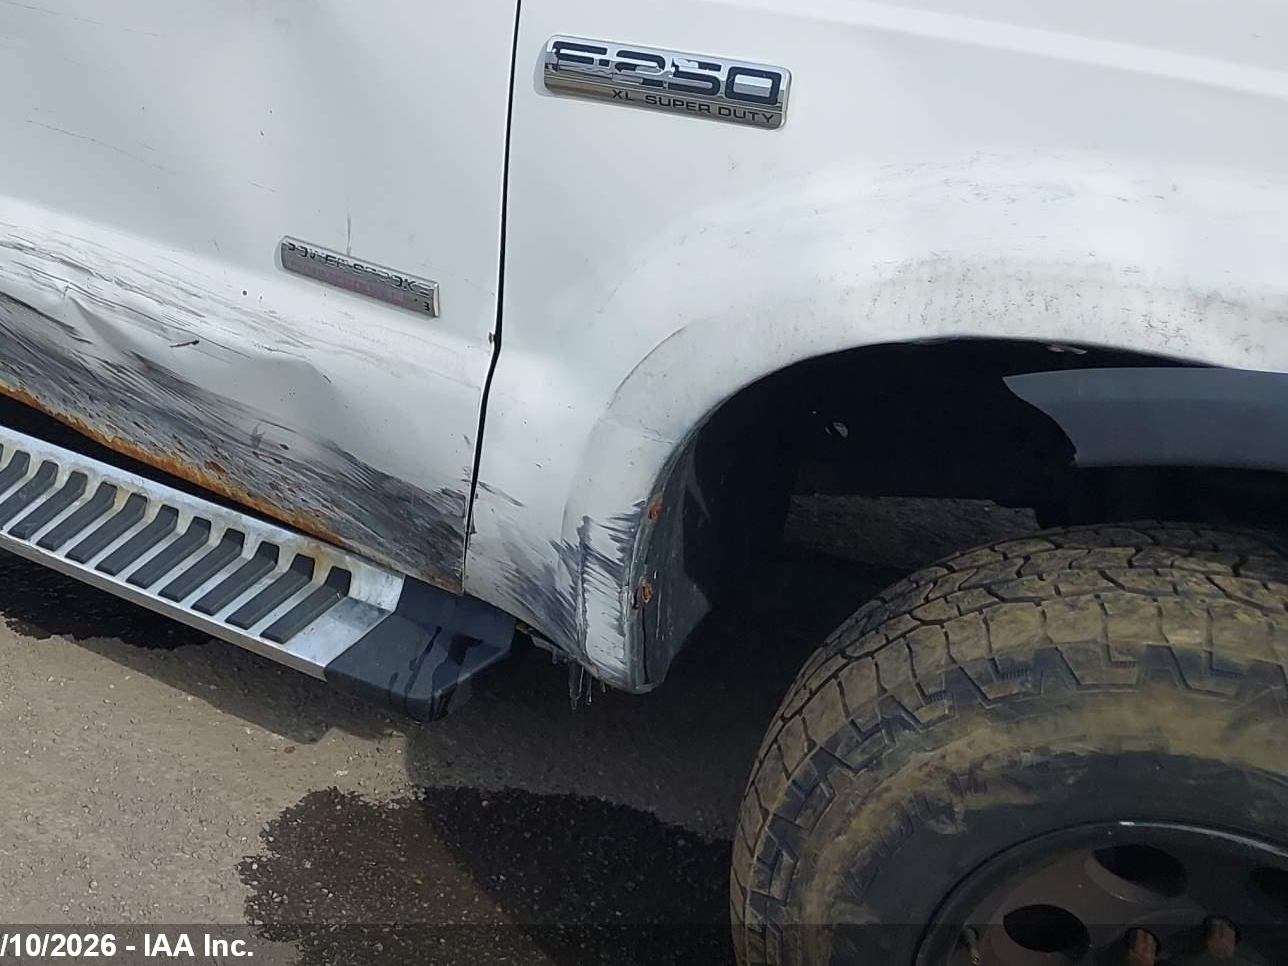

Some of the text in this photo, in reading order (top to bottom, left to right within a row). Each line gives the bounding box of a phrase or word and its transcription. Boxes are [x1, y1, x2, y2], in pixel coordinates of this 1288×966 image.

[611, 89, 776, 124] XL SUPER DUTY
